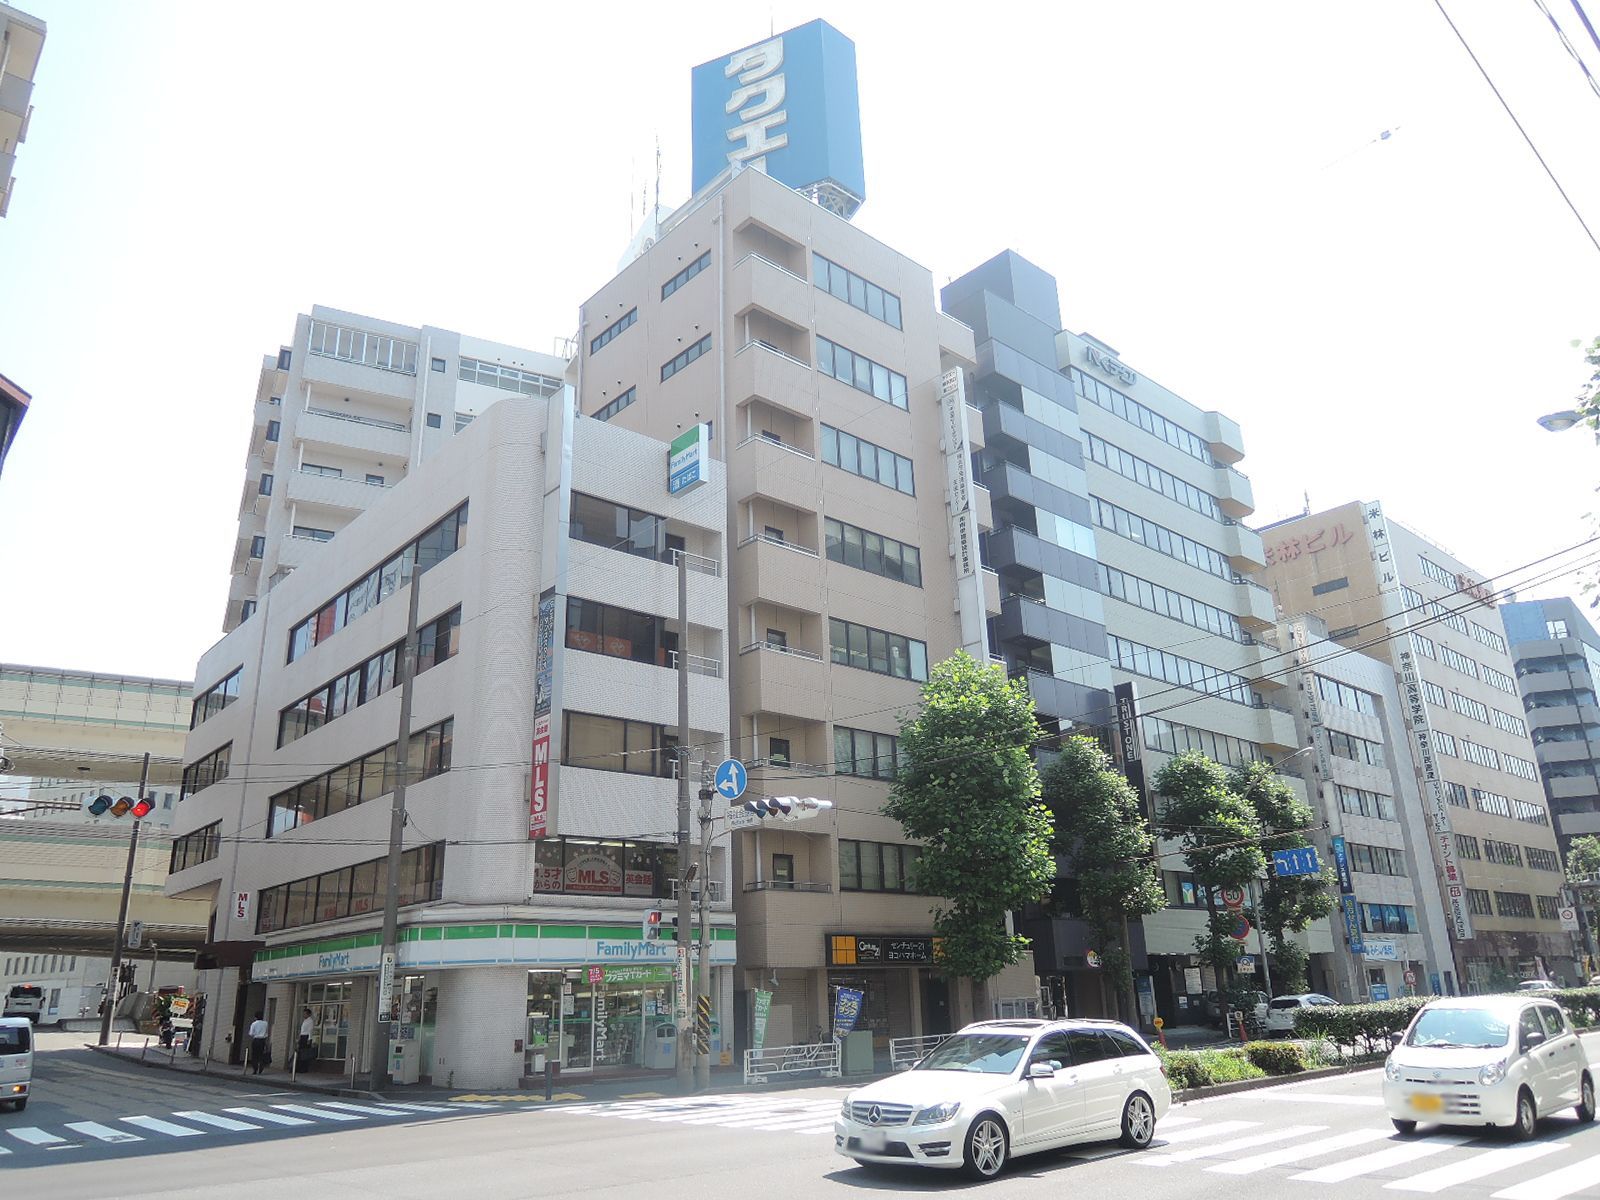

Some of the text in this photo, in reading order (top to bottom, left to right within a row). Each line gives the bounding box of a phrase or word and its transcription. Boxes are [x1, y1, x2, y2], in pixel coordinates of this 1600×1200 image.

[671, 448, 698, 468] FamilyMart
[1368, 507, 1394, 584] 米林ビル
[534, 741, 548, 812] MLS
[1440, 836, 1458, 881] テナント募集
[578, 869, 609, 884] MLS
[625, 873, 653, 885] 英会話
[237, 893, 248, 918] MLS
[318, 951, 350, 969] FamilyMart
[597, 941, 667, 960] FamilyMart
[888, 951, 927, 960] ヨコハマホーム
[594, 985, 609, 1061] FamilyMart
